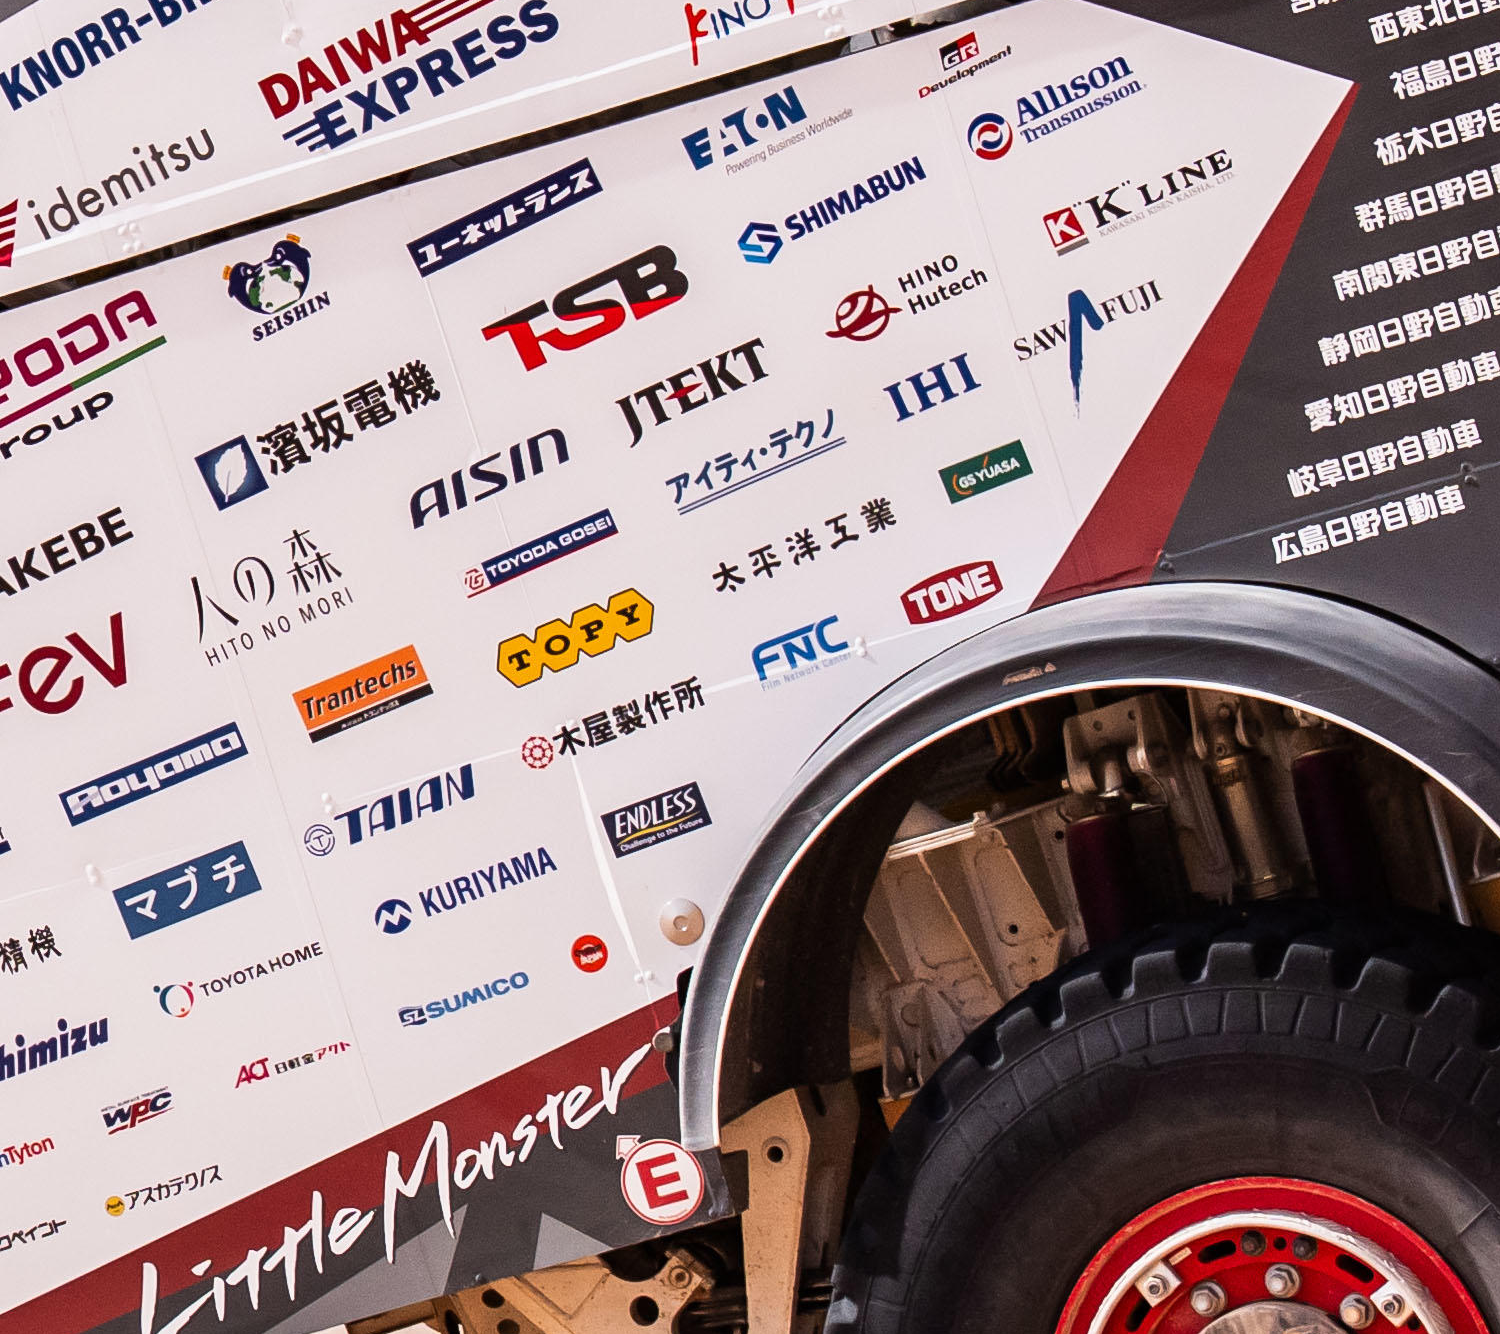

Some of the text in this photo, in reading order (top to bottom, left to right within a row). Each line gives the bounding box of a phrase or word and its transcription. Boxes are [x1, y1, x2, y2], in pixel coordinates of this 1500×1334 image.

[258, 8, 431, 120] DAIWA
[918, 44, 1012, 99] Development
[1015, 54, 1133, 128] Allison
[725, 107, 854, 176] Powering Business Worldwide
[1019, 80, 1142, 145] Transmission
[26, 127, 216, 242] idemitsu
[417, 168, 598, 270] ユーネットランス
[784, 156, 928, 241] SHIMABUN
[482, 245, 689, 371] TSB
[899, 253, 958, 294] HINO
[907, 268, 988, 316] Hutech
[252, 291, 332, 342] SEISHIN
[256, 359, 441, 477] 濱坂電機
[614, 338, 770, 449] JTEKT
[884, 352, 982, 423] IHI
[409, 428, 569, 530] AISIN
[959, 458, 1020, 488] GS YUASA
[1286, 419, 1482, 498] 岐阜日野自動車
[486, 515, 613, 581] TOYODA GOSEI
[713, 497, 898, 595] 太平洋工業
[1271, 485, 1465, 564] 広島日野自動車
[190, 530, 342, 644] 人の森
[909, 567, 994, 623] TONE
[206, 587, 354, 667] HITO NO MORI
[508, 603, 642, 671] TOPY
[751, 615, 849, 682] FNC
[302, 659, 416, 721] Trantechs
[556, 677, 704, 757] 木屋製作所
[334, 763, 475, 845] TAIAN
[615, 787, 697, 839] ENDLESS
[123, 854, 247, 921] マブチ
[419, 847, 557, 917] KURIYAMA
[200, 941, 323, 998] TOYOTA HOME
[426, 972, 530, 1019] SUMICO
[125, 1165, 223, 1210] アスカテクノス
[385, 1041, 652, 1265] Monster
[637, 1152, 689, 1209] E
